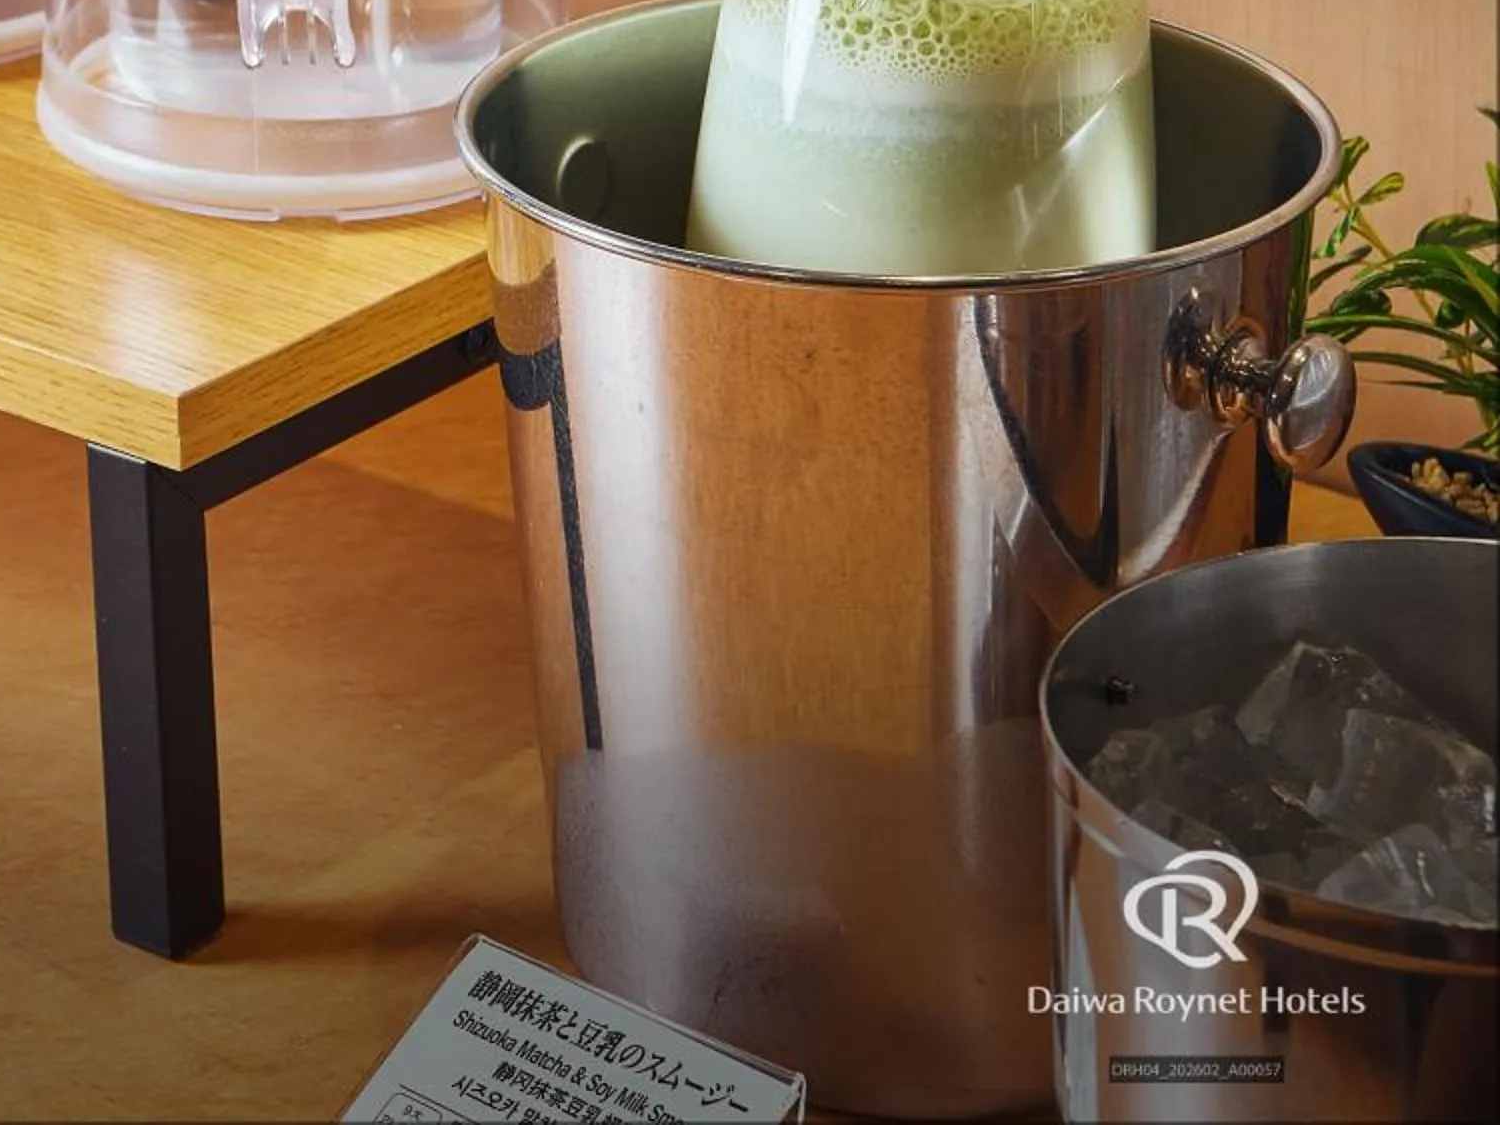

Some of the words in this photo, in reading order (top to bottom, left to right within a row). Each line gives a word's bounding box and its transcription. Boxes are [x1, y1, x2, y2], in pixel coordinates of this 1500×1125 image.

[452, 1009, 518, 1053] Shizuoka
[515, 1039, 572, 1079] Matcha
[570, 1065, 587, 1086] &
[585, 1074, 616, 1104] Soy
[613, 1086, 650, 1117] Milk
[467, 970, 749, 1113] 静岡抹茶と豆乳のスムージー
[451, 1075, 521, 1121] 시즈오카
